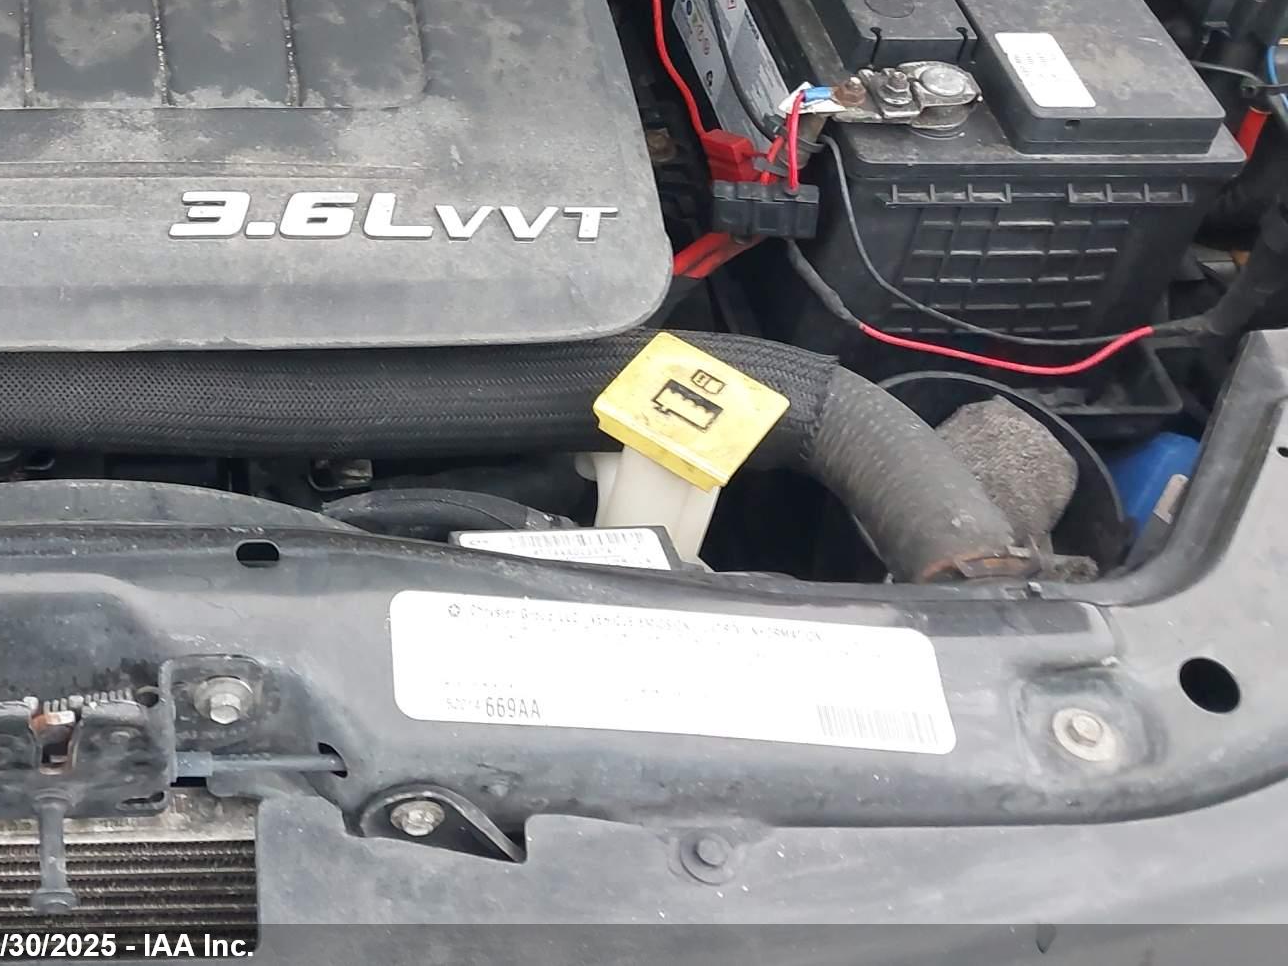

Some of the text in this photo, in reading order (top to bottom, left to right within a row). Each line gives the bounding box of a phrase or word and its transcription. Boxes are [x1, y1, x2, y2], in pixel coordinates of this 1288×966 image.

[169, 191, 619, 242] 3.6L VVT
[485, 697, 541, 719] 669AA
